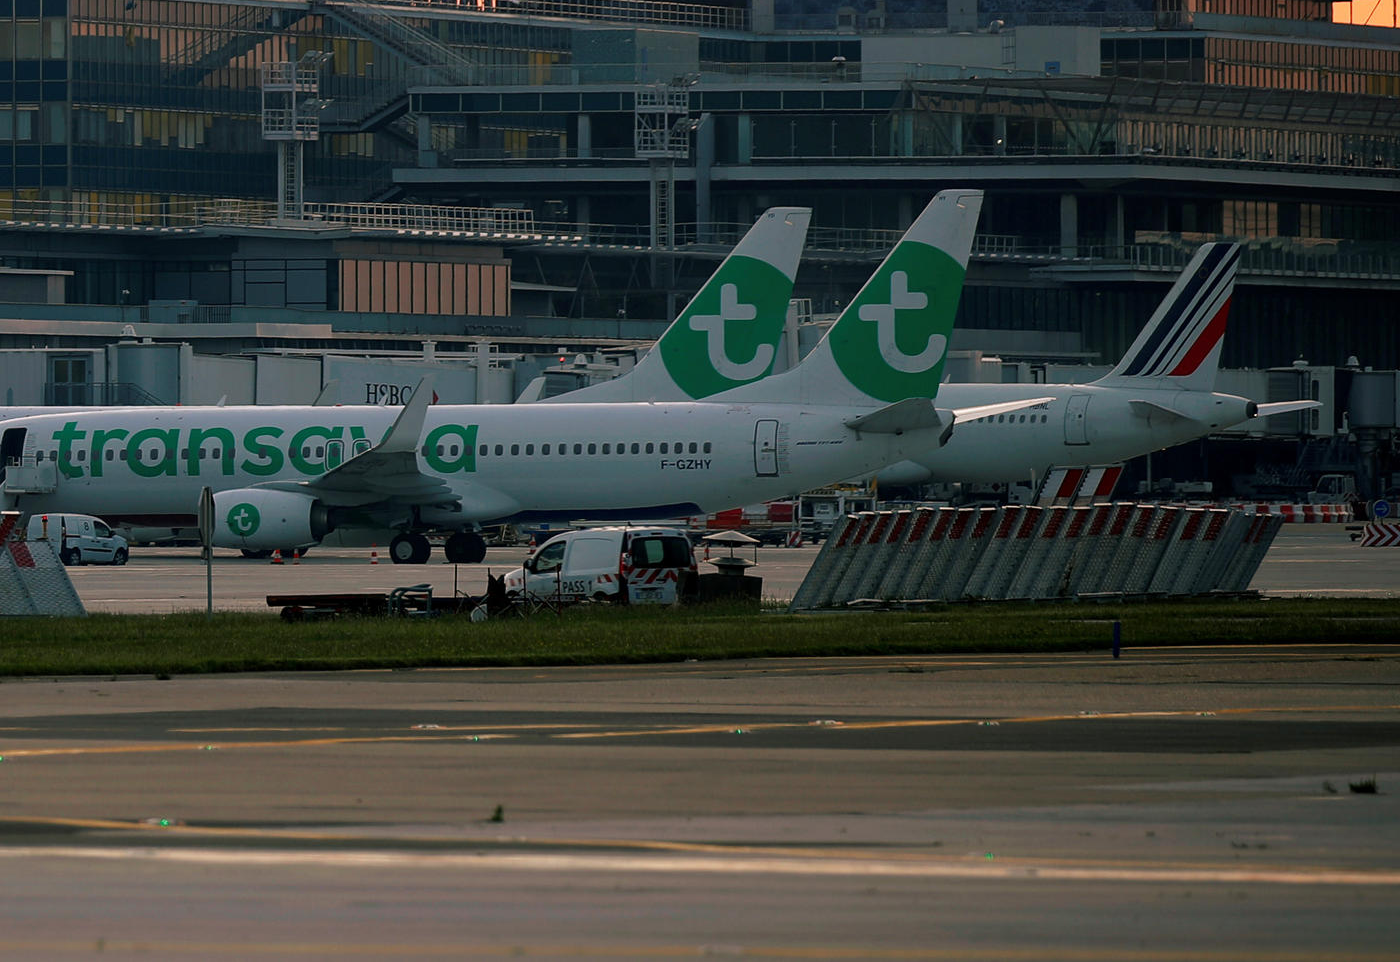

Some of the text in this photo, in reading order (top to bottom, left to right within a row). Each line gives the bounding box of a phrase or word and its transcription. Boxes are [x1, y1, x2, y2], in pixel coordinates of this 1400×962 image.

[52, 421, 480, 479] transava
[660, 459, 712, 470] F-GZHY
[562, 580, 585, 593] PASS
